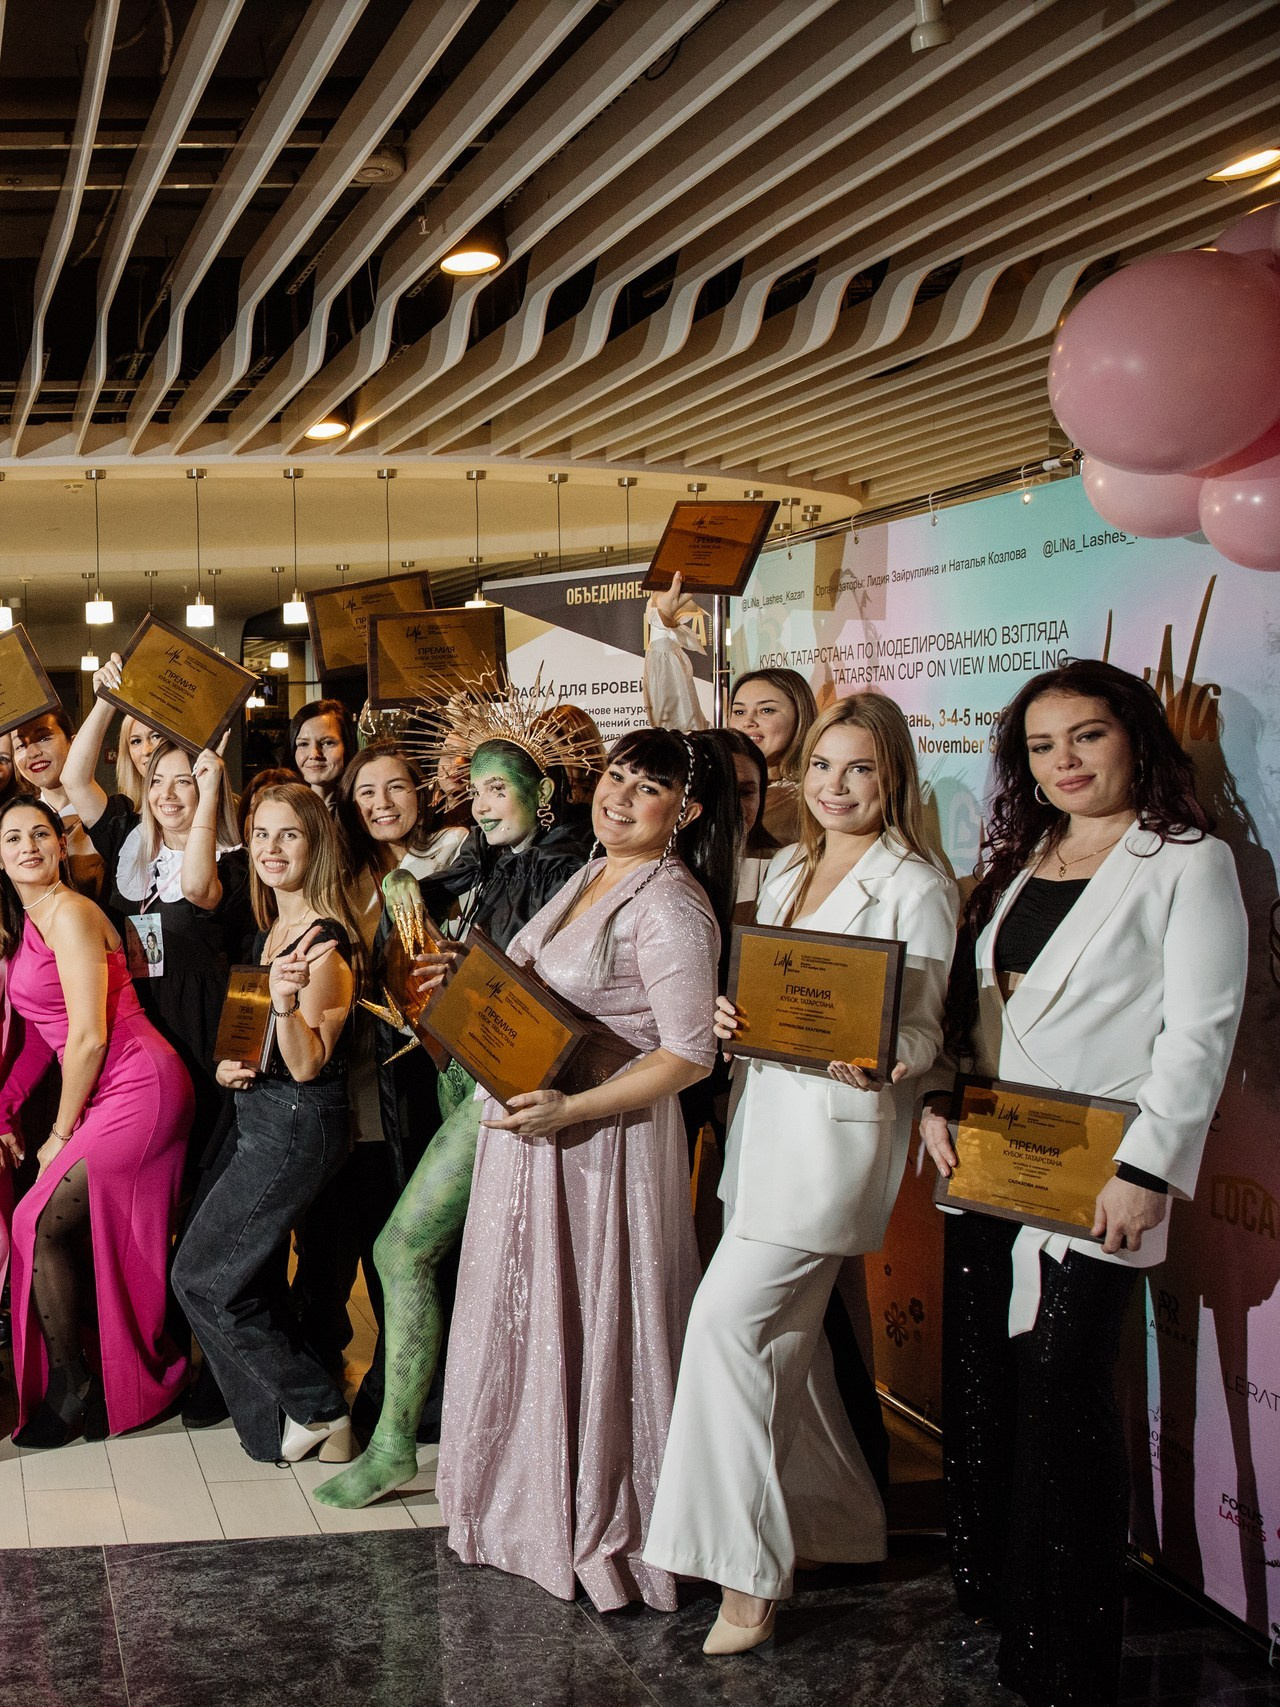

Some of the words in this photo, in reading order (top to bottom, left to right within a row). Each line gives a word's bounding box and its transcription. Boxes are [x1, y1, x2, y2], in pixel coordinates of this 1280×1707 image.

[815, 578, 866, 597] Организаторы:
[866, 573, 890, 588] Лидия
[891, 563, 939, 583] Зайруллина
[941, 564, 947, 573] и
[949, 555, 986, 572] Наталья
[988, 548, 1027, 565] Козлова
[417, 645, 455, 655] ПРЕМИЯ
[759, 651, 789, 669] КУБОК
[790, 644, 854, 667] ТАТАРСТАНА
[857, 642, 874, 660] ПО
[877, 627, 997, 658] МОДЕЛИРОВАНИЮ
[1001, 619, 1070, 645] ВЗГЛЯДА
[833, 664, 895, 685] TATARSTAN
[898, 661, 924, 680] CUP
[926, 658, 947, 678] ON
[950, 655, 985, 676] VIEW
[163, 669, 197, 692] ПРЕМИЯ
[558, 683, 587, 699] ДЛЯ
[939, 708, 971, 726] 3-4-5
[918, 735, 985, 754] November
[779, 995, 799, 1004] КУБОК
[799, 998, 834, 1009] ТАТАРСТАНА
[785, 984, 831, 1000] ПРЕМИЯ
[483, 1005, 518, 1039] ПРЕМИЯ
[1002, 1149, 1023, 1159] КУБОК
[1024, 1153, 1063, 1167] ТАТАРСТАНА
[1008, 1138, 1060, 1158] ПРЕМИЯ
[1221, 1493, 1264, 1526] FOCUS
[1219, 1505, 1267, 1542] LASHES
